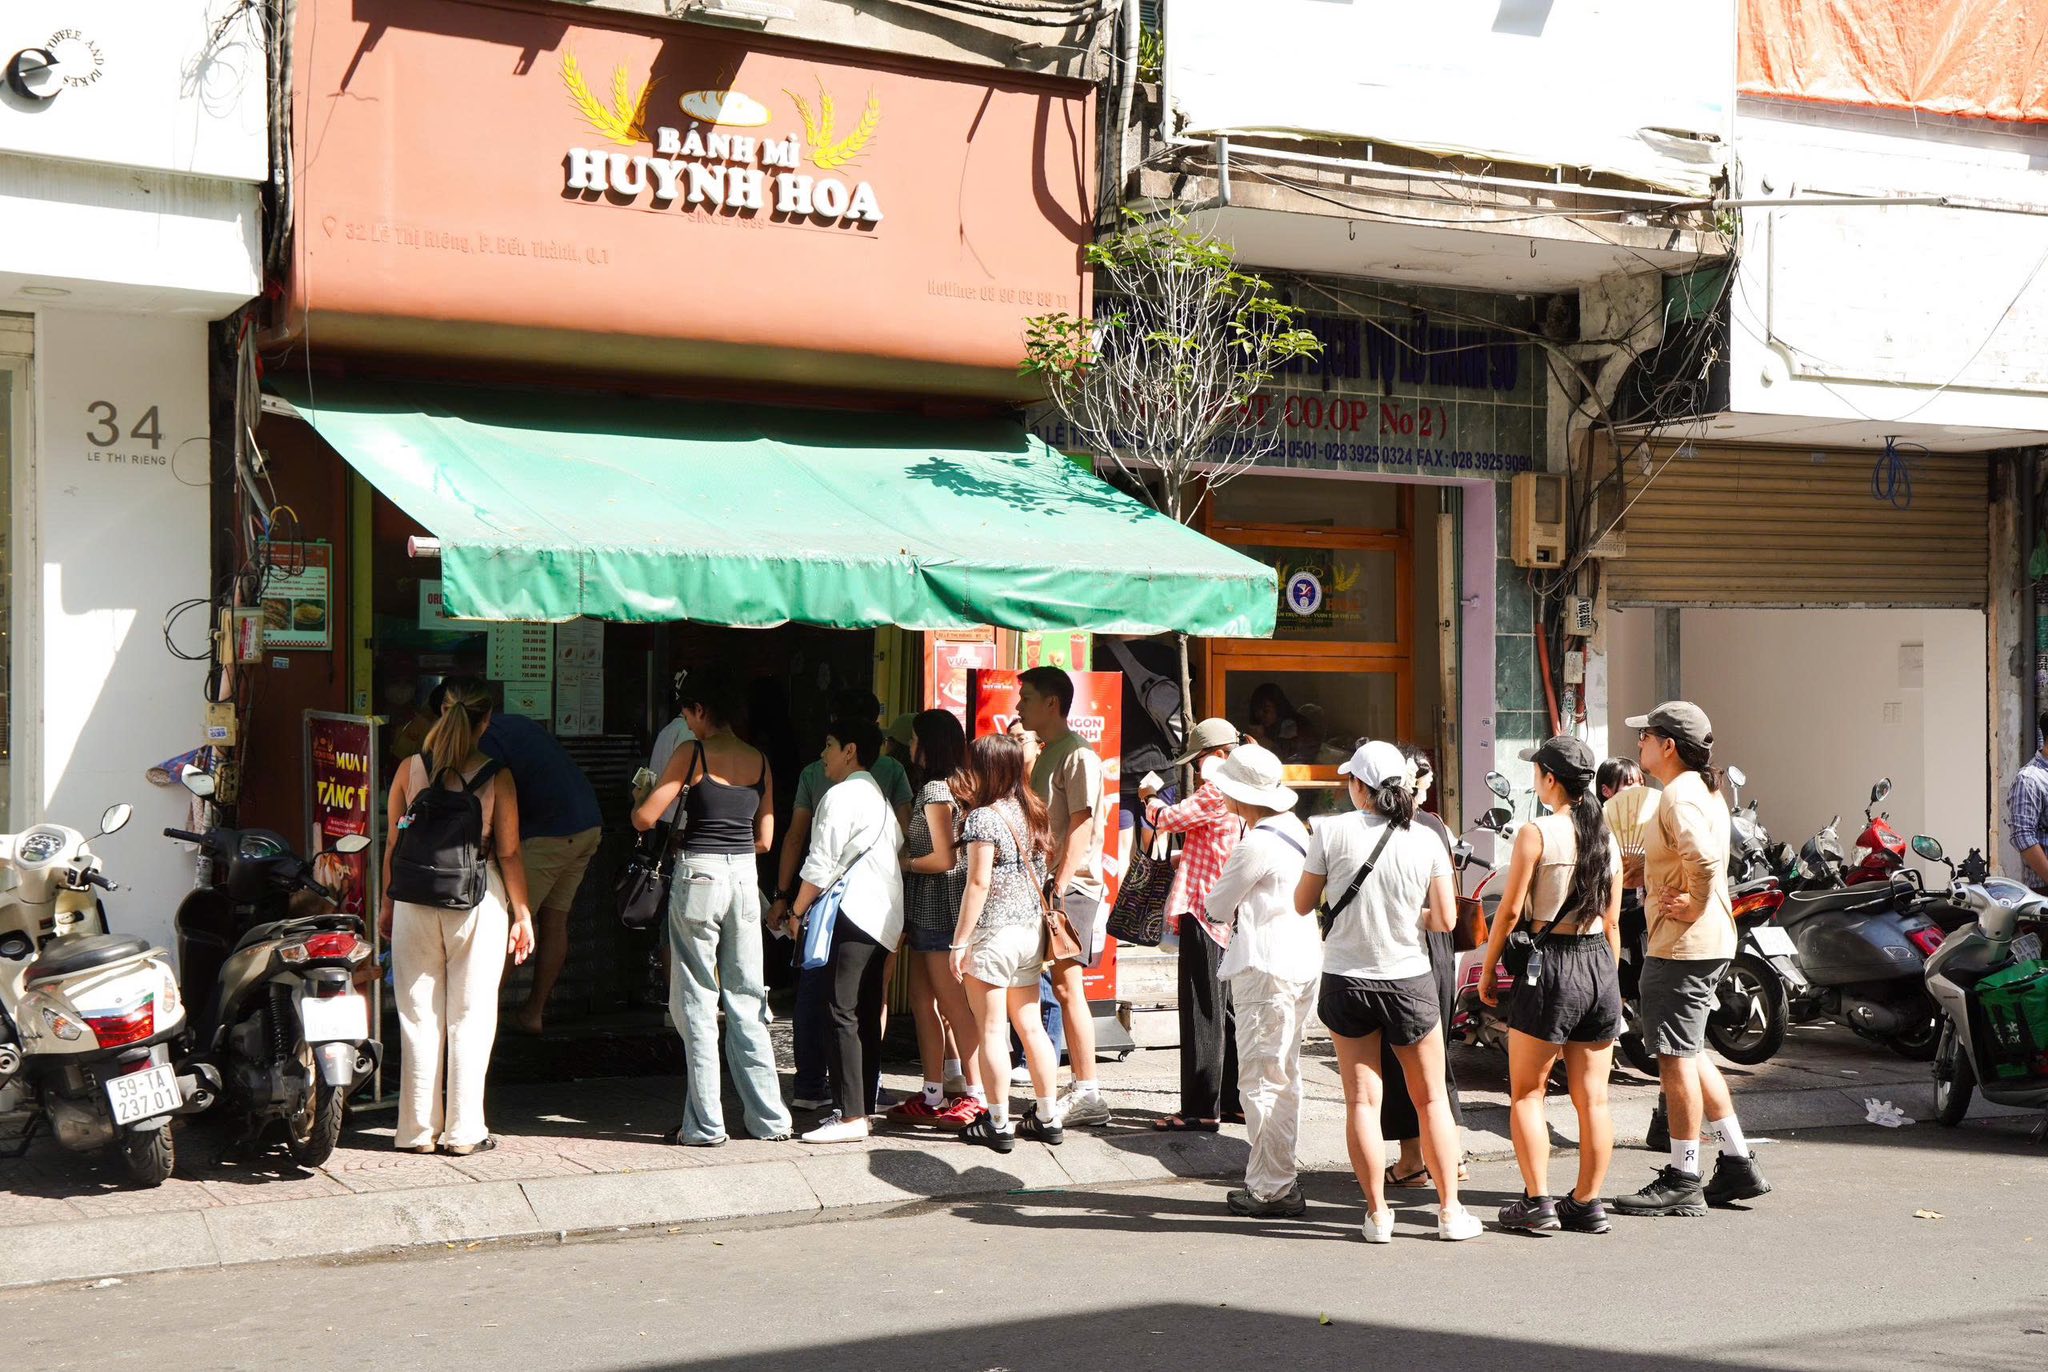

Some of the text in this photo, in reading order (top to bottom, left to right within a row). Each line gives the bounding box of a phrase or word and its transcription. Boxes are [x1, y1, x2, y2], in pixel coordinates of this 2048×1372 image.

[657, 121, 755, 165] BÁNH
[567, 147, 885, 222] HUYNH HOA
[687, 208, 731, 227] SINCE
[86, 400, 163, 450] 34
[87, 452, 167, 466] LE THI RIENG
[335, 750, 362, 773] MUA
[316, 775, 355, 814] TẶNG
[117, 1070, 166, 1098] 59-TA
[119, 1088, 175, 1121] 237.01
